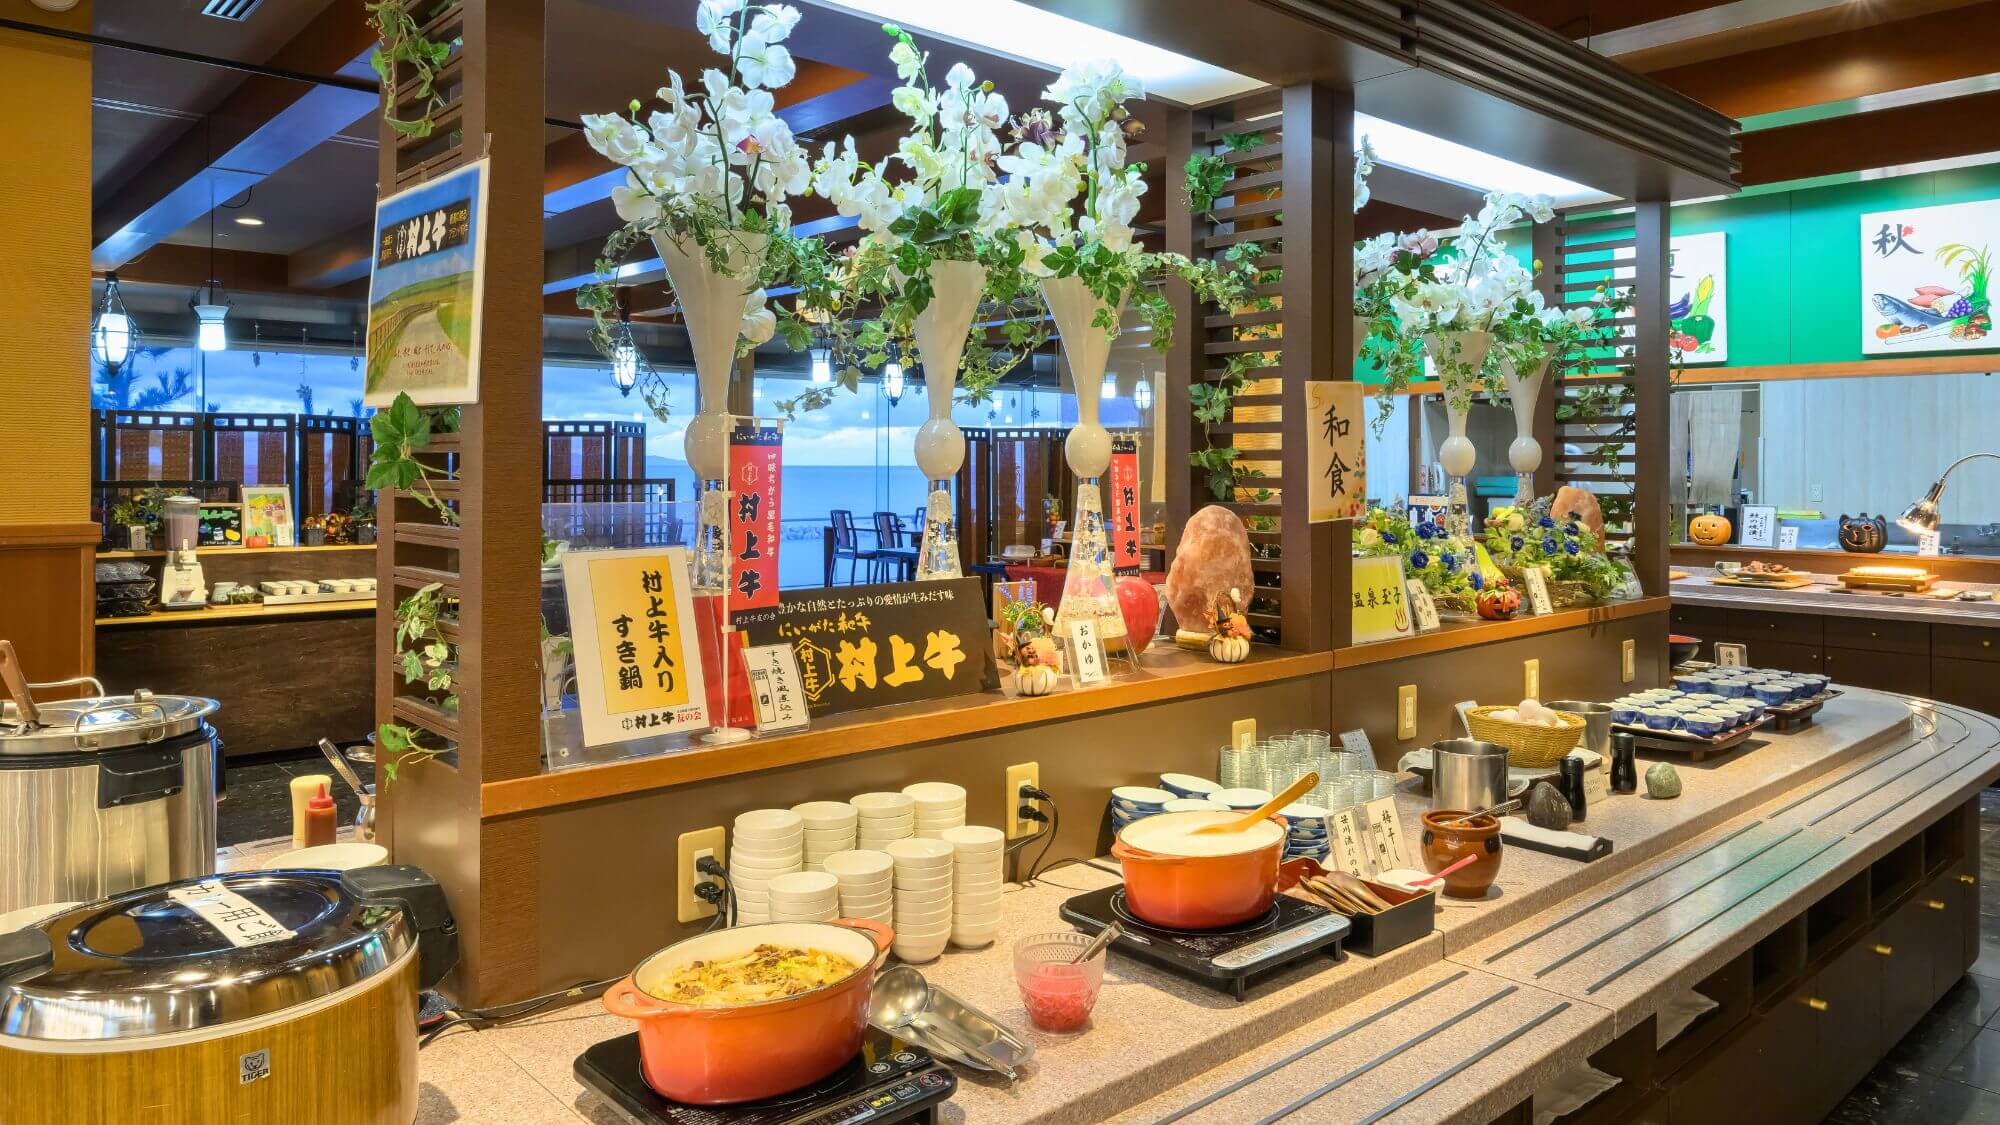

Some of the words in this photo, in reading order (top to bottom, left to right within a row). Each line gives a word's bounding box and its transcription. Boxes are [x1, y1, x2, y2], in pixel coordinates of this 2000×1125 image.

[407, 209, 446, 258] 村上牛
[1872, 223, 1924, 258] 秋
[1323, 405, 1351, 498] 和食
[738, 492, 762, 600] 村上牛
[641, 570, 675, 692] 村上牛入り
[779, 611, 872, 637] にいがた和牛
[1080, 625, 1094, 664] おかゆ
[612, 614, 643, 690] すき鍋
[800, 648, 820, 692] 村上牛
[836, 630, 967, 692] 村上牛
[634, 711, 675, 730] 村上牛
[1382, 810, 1400, 862] 梅干し
[241, 1068, 269, 1082] TIGER
